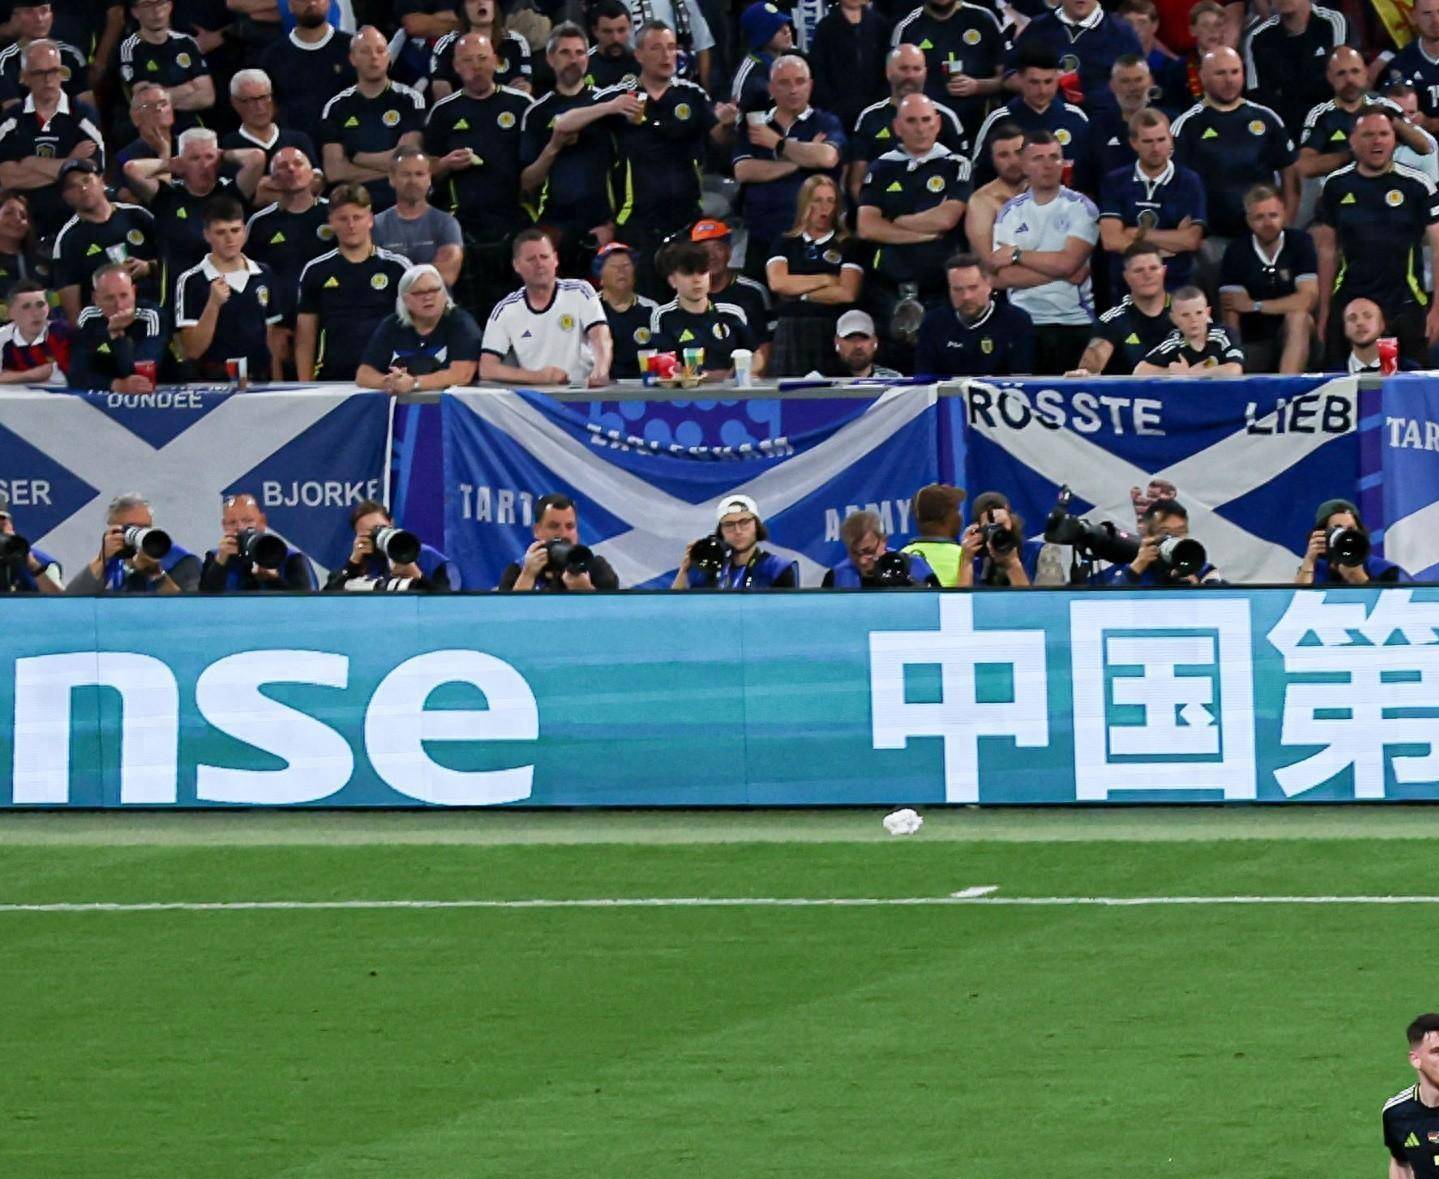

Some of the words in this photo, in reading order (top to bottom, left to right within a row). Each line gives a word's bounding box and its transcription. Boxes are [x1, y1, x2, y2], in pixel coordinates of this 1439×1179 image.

[968, 382, 1167, 436] RÖSSTE
[1245, 393, 1352, 435] LIEB
[13, 649, 541, 805] nse
